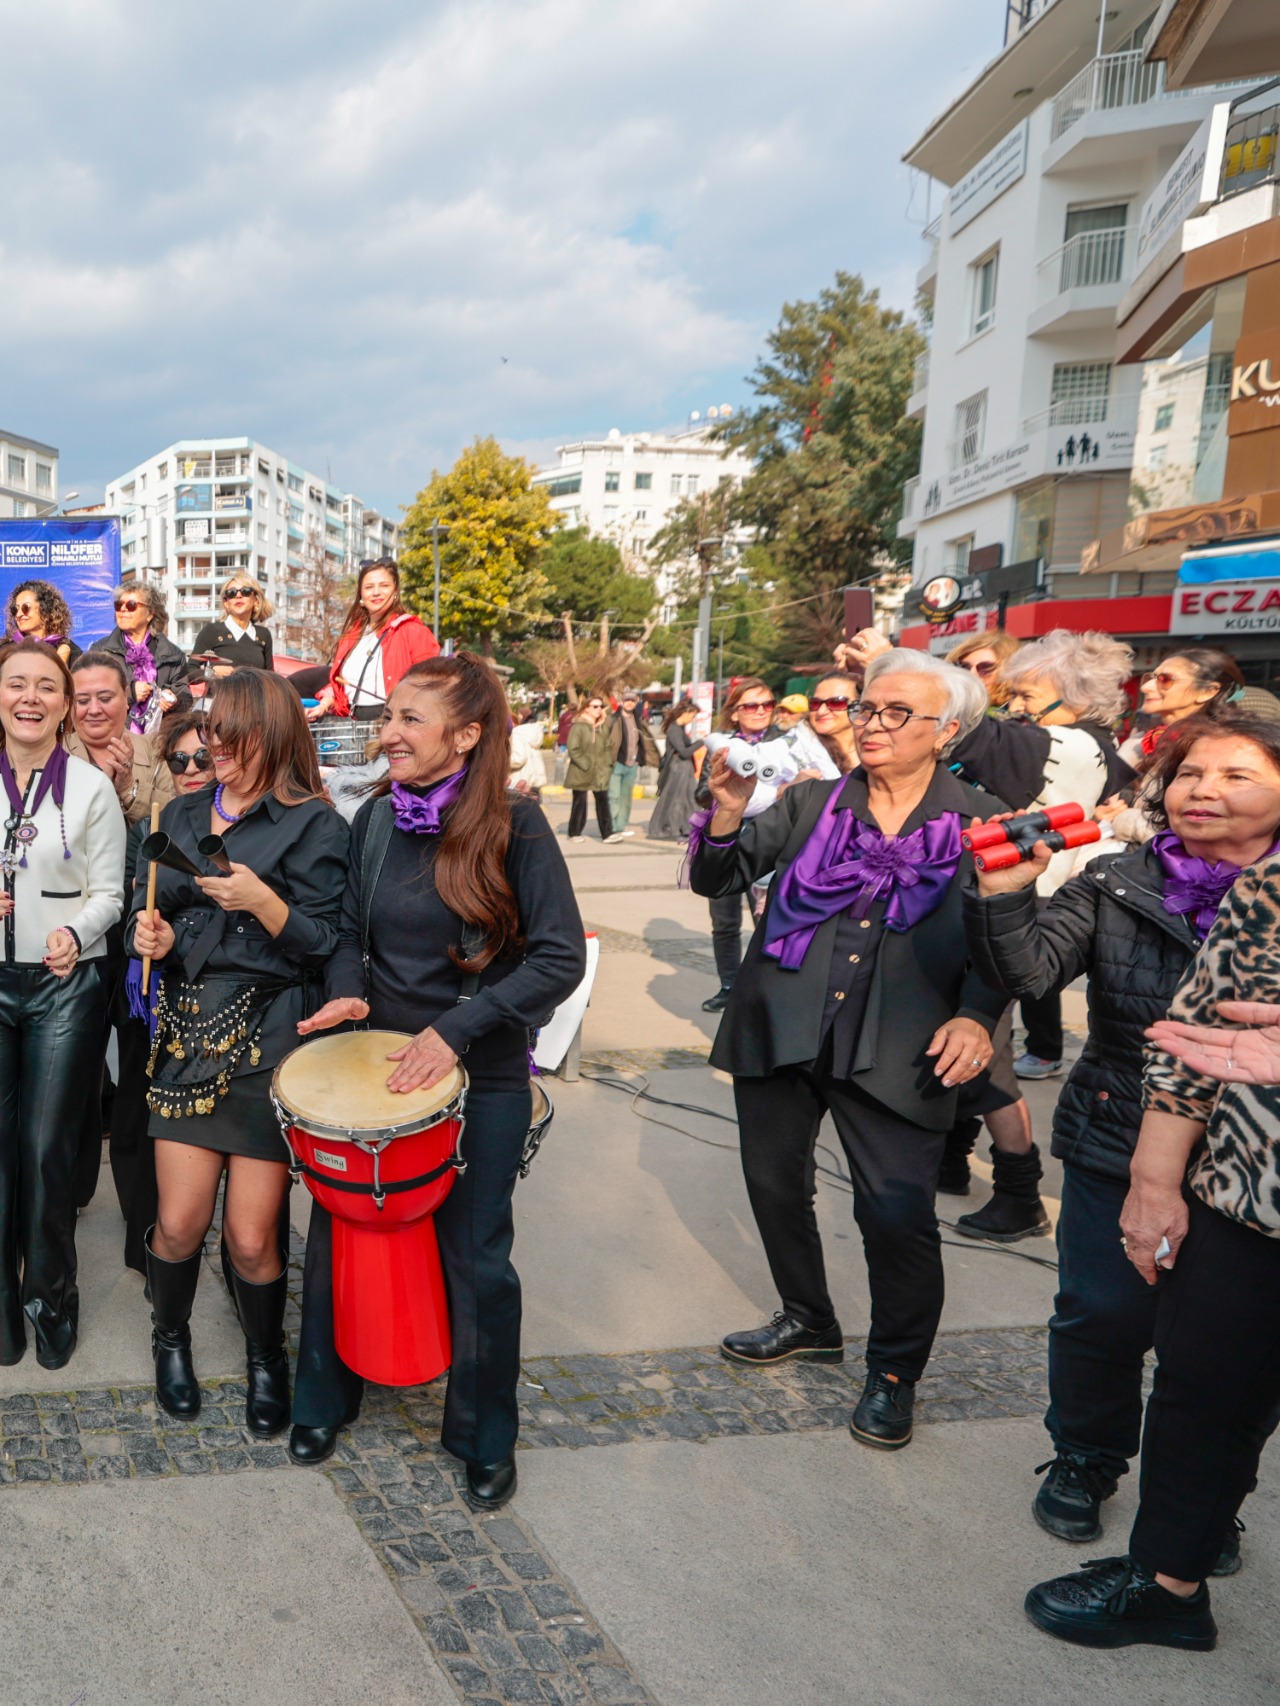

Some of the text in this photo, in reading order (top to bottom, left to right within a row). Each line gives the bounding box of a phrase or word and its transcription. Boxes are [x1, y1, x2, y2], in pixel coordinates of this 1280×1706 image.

[6, 546, 45, 556] KONAK
[51, 544, 103, 555] NİLÜFER
[1180, 588, 1280, 615] ECZA
[1224, 614, 1280, 630] KÜLTÜ
[316, 1151, 345, 1169] Swing
